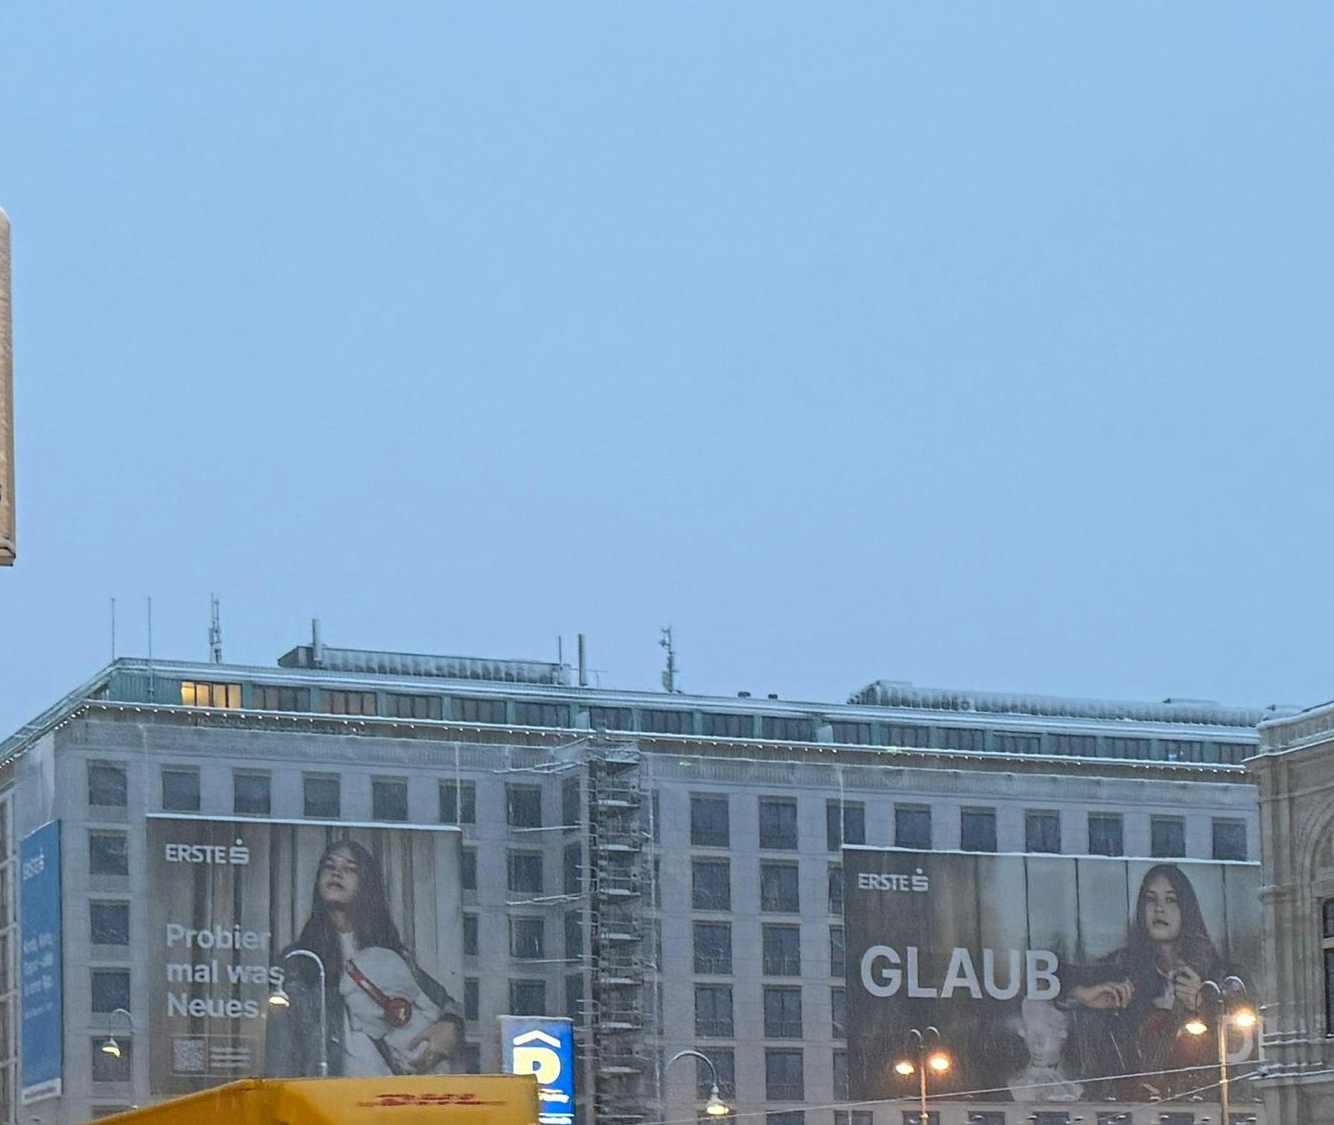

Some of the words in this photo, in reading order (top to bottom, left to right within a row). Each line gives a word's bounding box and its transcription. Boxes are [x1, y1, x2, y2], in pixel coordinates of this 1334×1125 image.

[166, 843, 226, 864] ERSTE
[858, 873, 910, 891] ERSTE
[166, 922, 271, 950] Probier
[167, 959, 218, 983] mal
[227, 964, 285, 985] was
[860, 944, 1062, 1000] GLAUB
[167, 992, 267, 1019] Neues.
